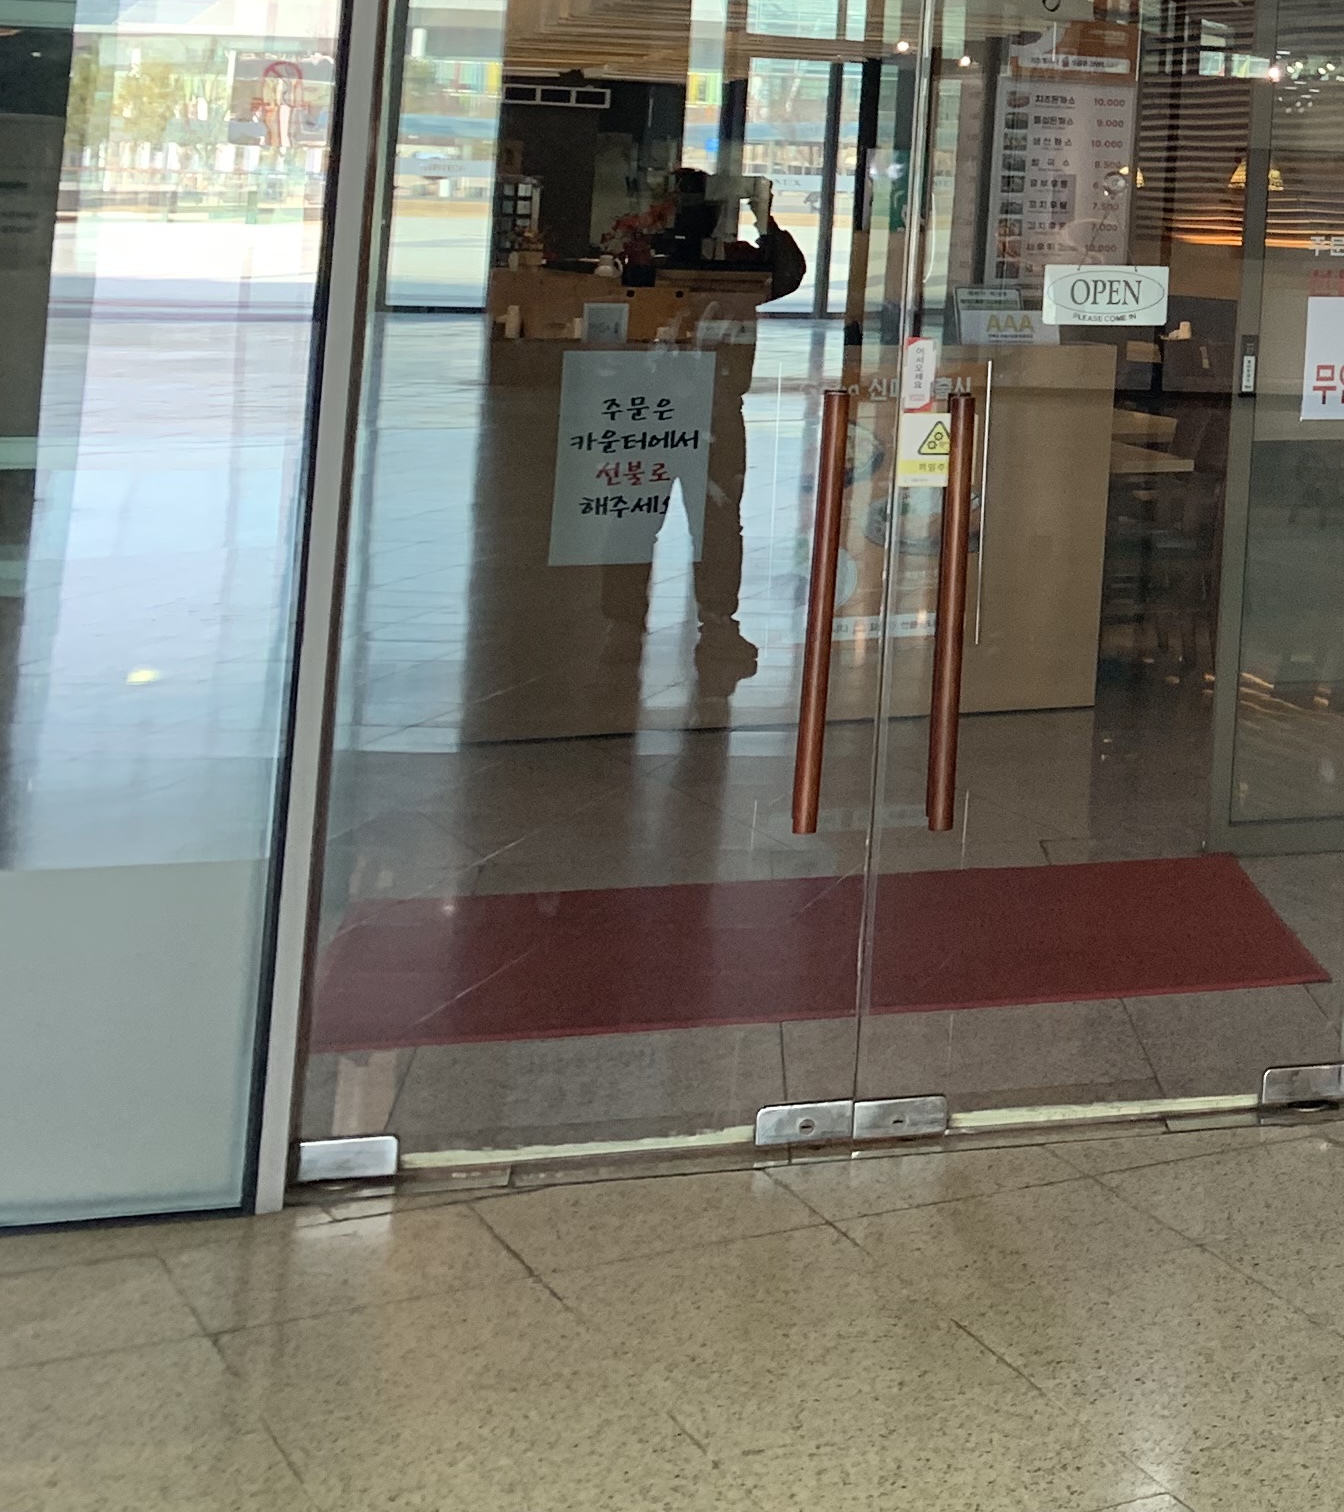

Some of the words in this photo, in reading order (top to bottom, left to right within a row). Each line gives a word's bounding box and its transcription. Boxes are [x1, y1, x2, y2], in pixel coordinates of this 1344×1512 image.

[1070, 278, 1142, 306] OPEN
[1072, 312, 1103, 323] PLEASE
[1103, 314, 1127, 323] COME
[915, 347, 926, 390] 어서오세요
[600, 395, 676, 423] 주문은
[569, 429, 700, 453] 카운터에서
[594, 461, 672, 487] 선불로
